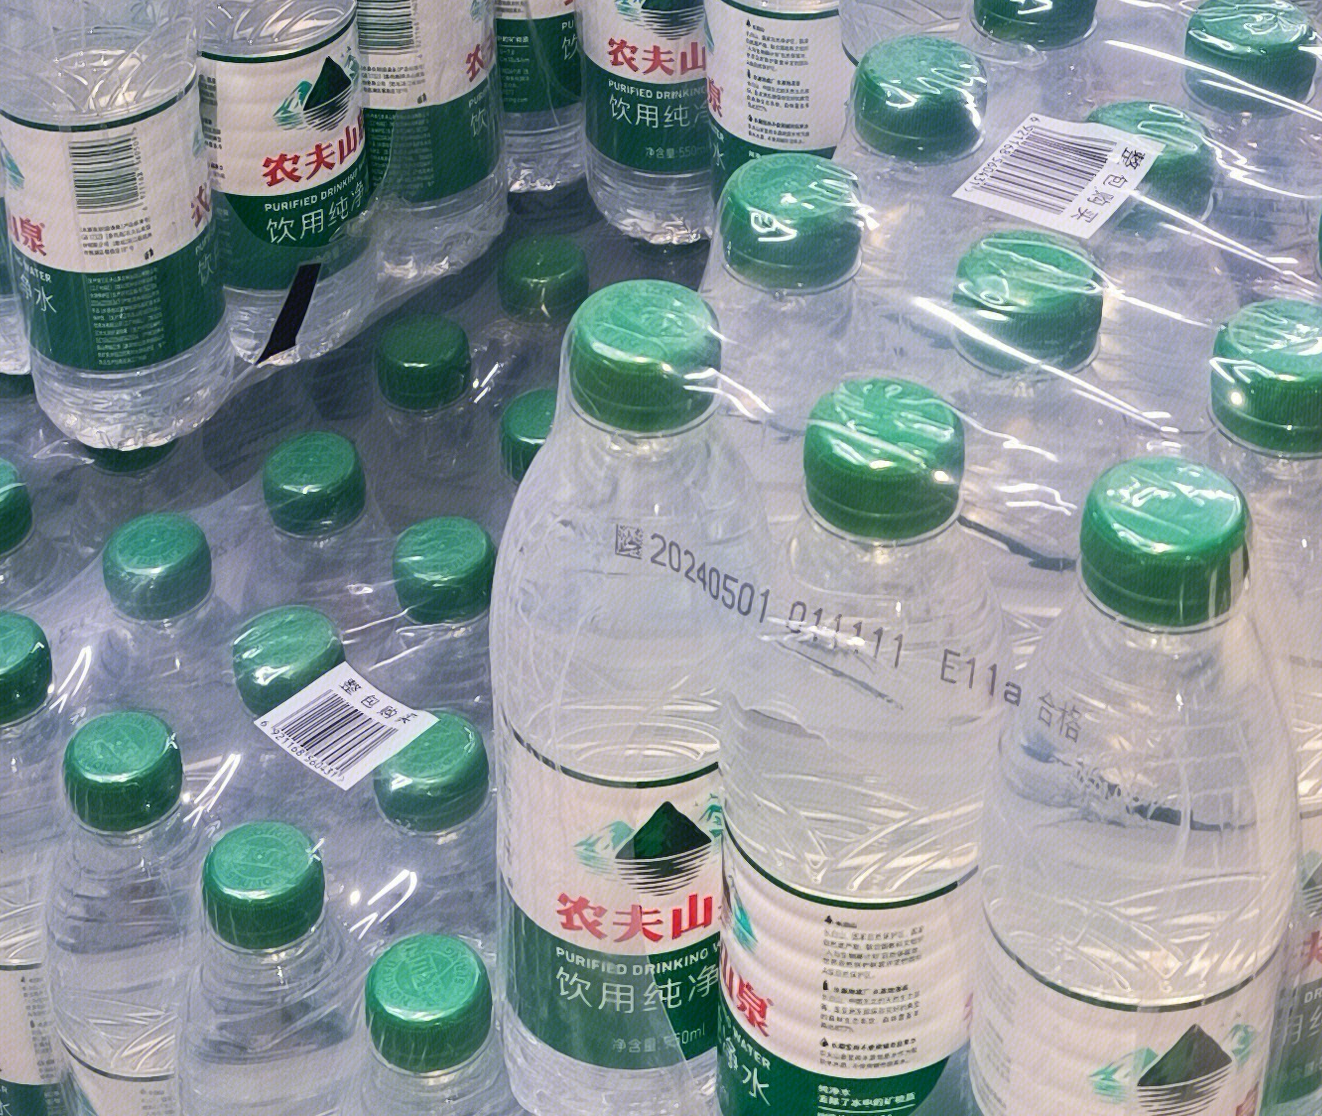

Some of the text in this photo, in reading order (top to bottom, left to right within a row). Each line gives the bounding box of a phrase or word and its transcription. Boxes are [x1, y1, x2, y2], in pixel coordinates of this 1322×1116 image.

[608, 79, 653, 100] PURIFIED
[262, 112, 365, 187] 农夫山
[999, 123, 1037, 156] 921168
[972, 155, 1005, 189] 560431
[1070, 146, 1146, 223] 整包购买
[264, 194, 317, 212] PURIFIED
[650, 534, 771, 623] 20240501
[940, 648, 1023, 706] E11a
[1036, 690, 1084, 742] 合格
[338, 677, 419, 726] 整包购买
[271, 726, 306, 758] 921168
[556, 893, 724, 944] 农夫山
[555, 945, 627, 977] PURIFIED
